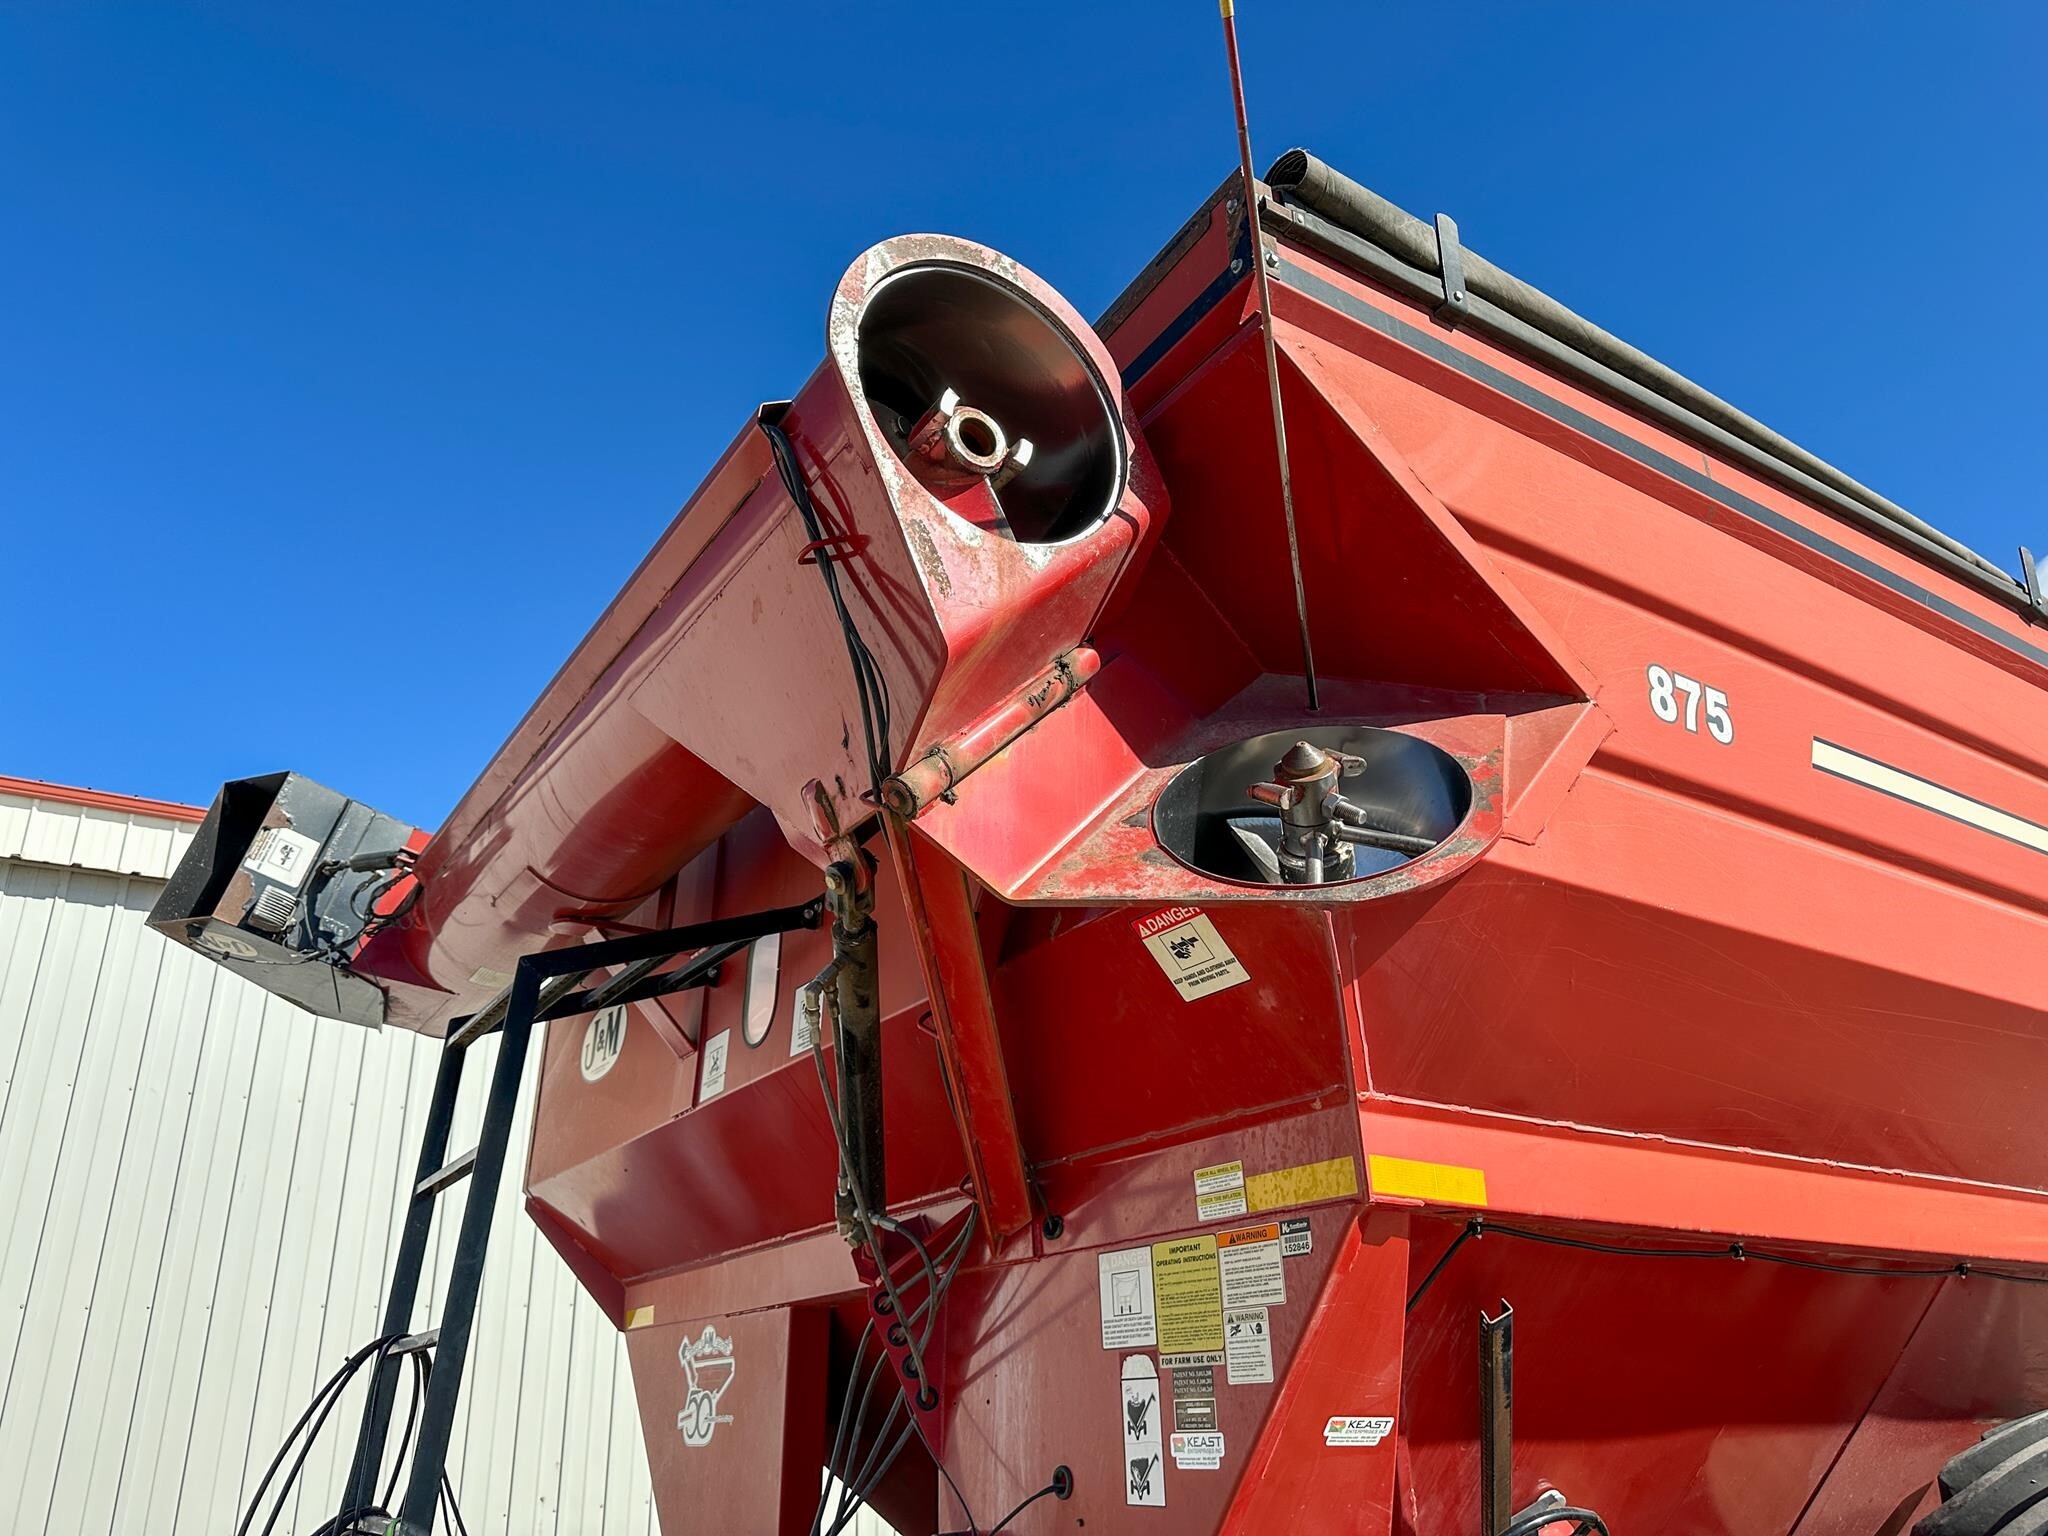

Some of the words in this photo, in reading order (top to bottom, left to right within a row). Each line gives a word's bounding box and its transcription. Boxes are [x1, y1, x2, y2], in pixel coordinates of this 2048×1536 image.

[1646, 664, 1734, 745] 875
[1146, 907, 1200, 932] DANGER
[1205, 962, 1225, 973] CLOTHING
[1199, 974, 1216, 983] MOVING
[585, 1005, 624, 1071] J&M
[1235, 1229, 1268, 1241] WARNING
[1168, 1243, 1201, 1255] IMPORTANT
[1284, 1242, 1310, 1253] 152846
[1156, 1257, 1182, 1267] OPERATING
[1182, 1253, 1216, 1263] INSTRUCTIONS
[1235, 1312, 1264, 1322] WARNING
[1161, 1357, 1173, 1366] FOR
[1174, 1356, 1191, 1364] FARM
[1192, 1355, 1205, 1364] USE
[1206, 1354, 1222, 1363] ONLY
[1348, 1420, 1391, 1429] KEAST
[1187, 1436, 1221, 1448] KEAST
